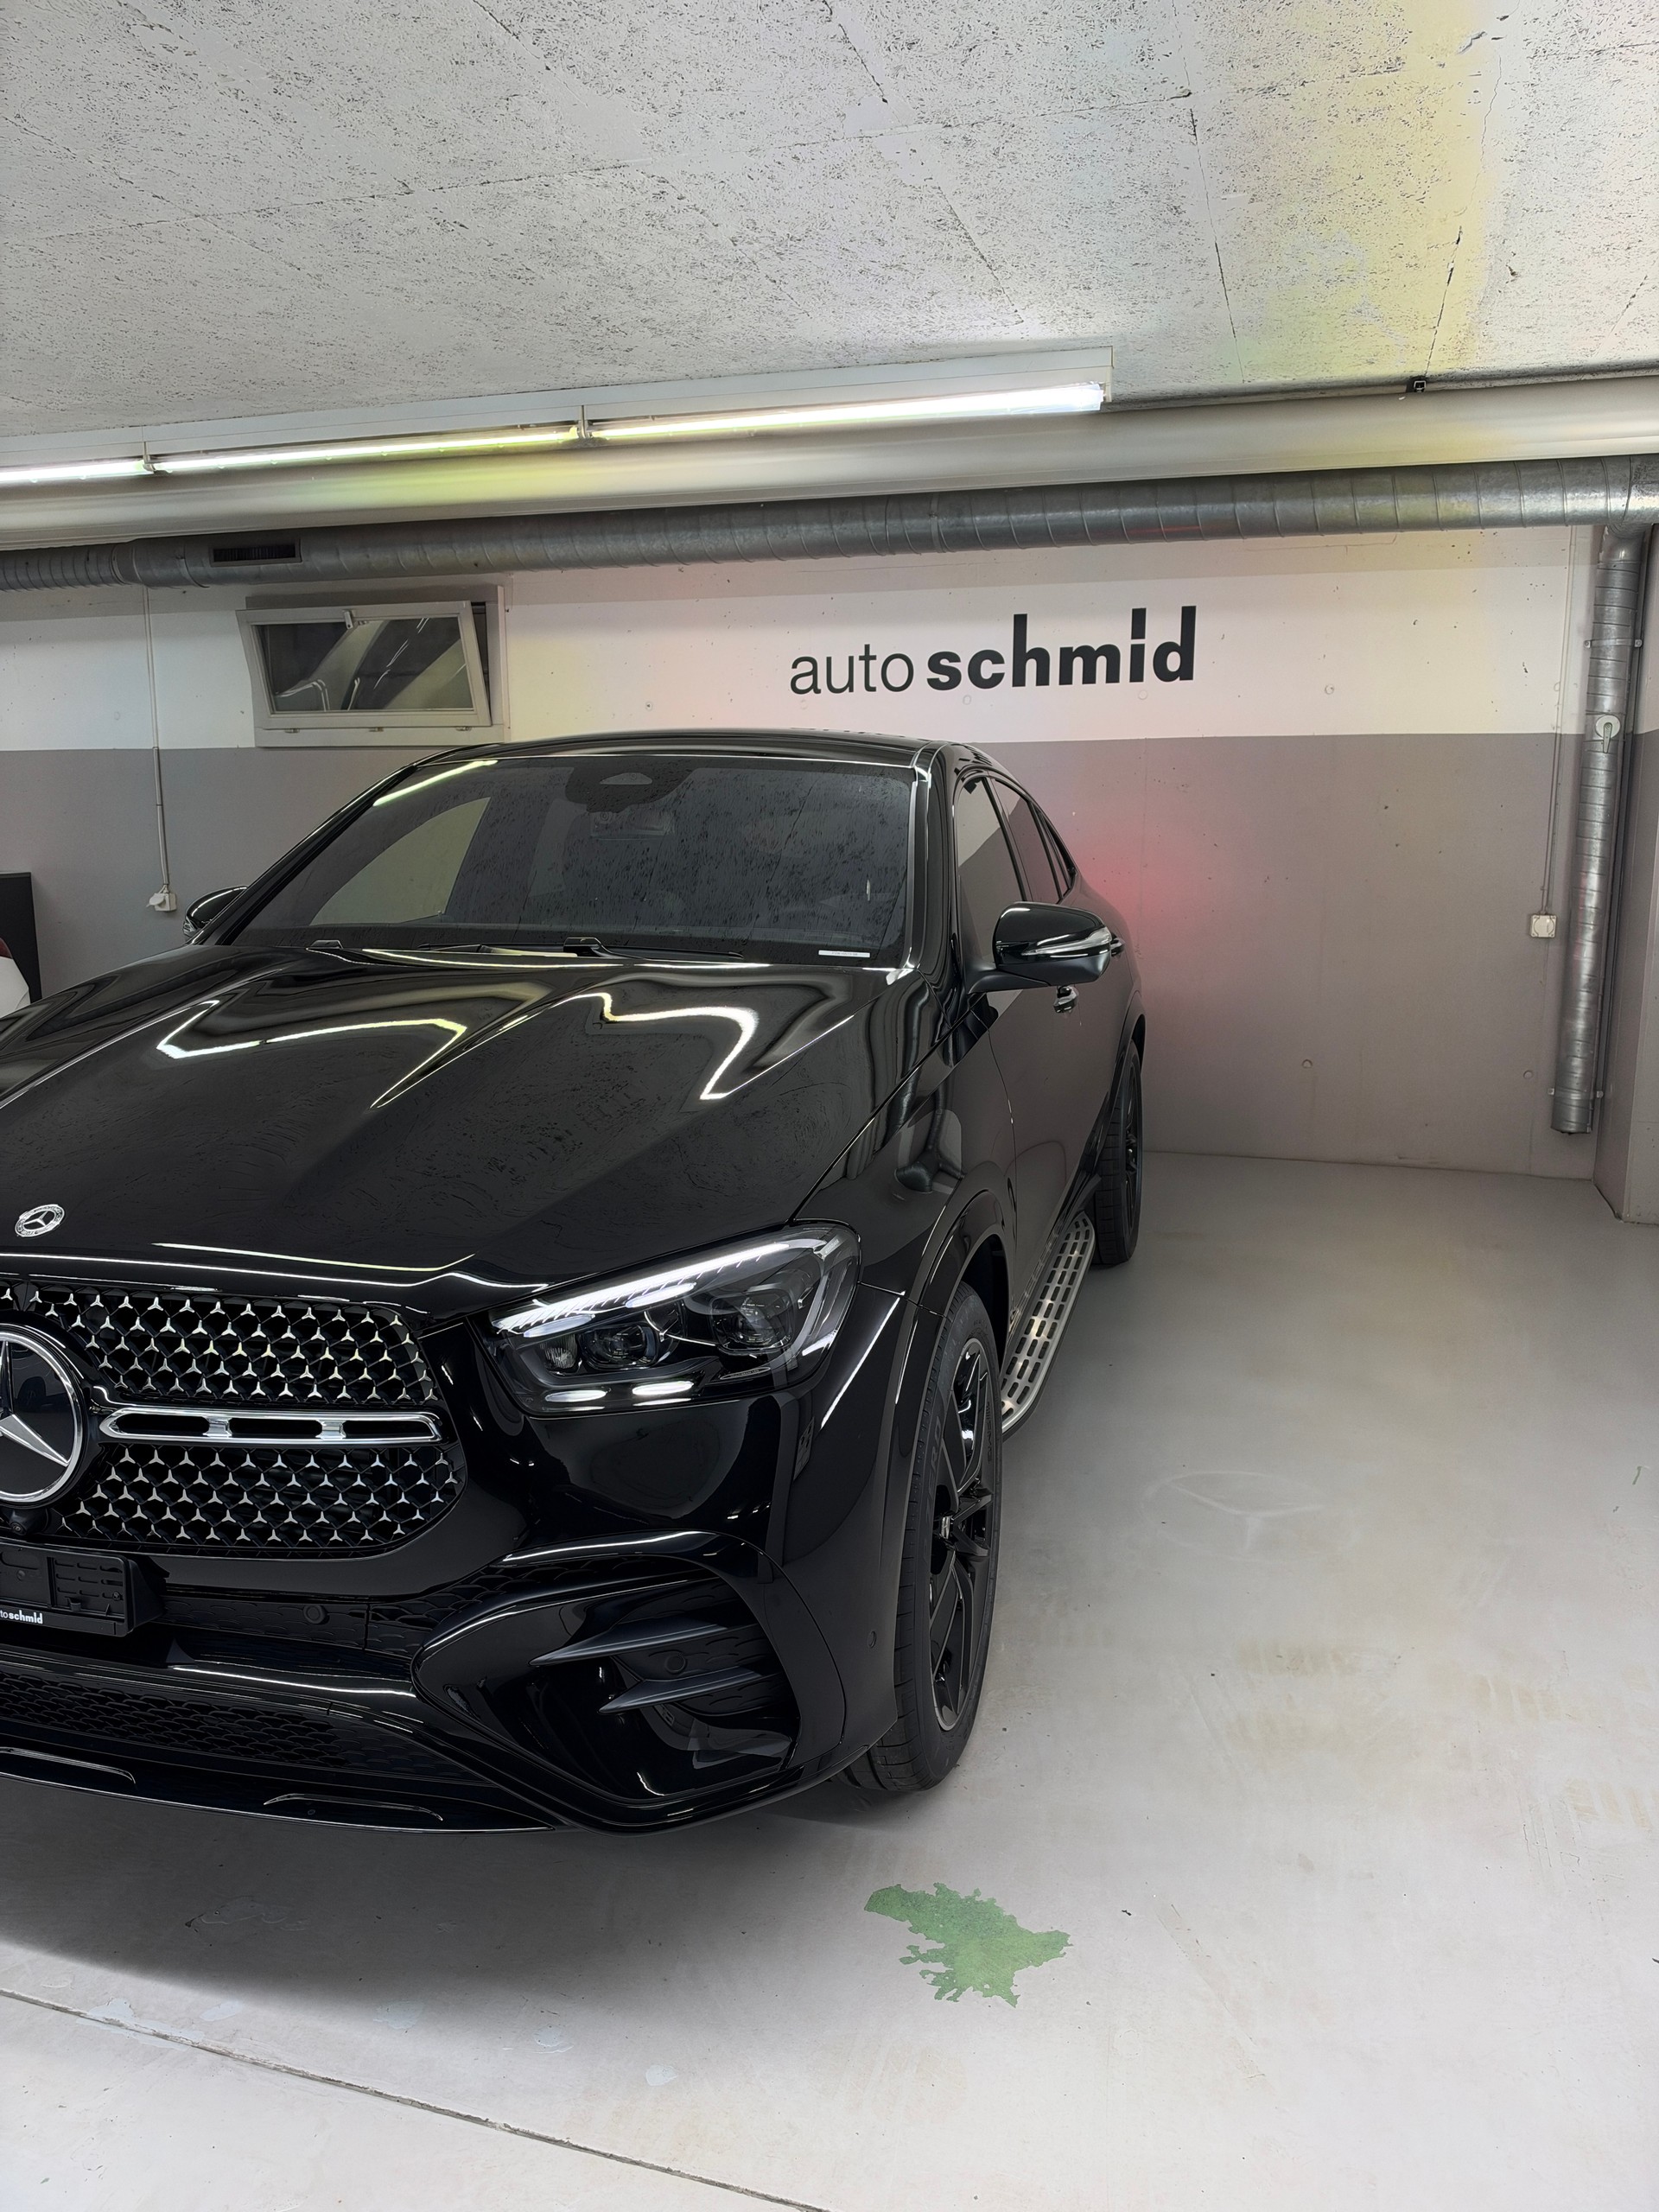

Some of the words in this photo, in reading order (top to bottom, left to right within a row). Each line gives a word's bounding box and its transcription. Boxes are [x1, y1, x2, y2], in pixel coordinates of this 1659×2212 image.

[790, 644, 914, 695] auto
[926, 606, 1197, 690] schmid
[925, 1414, 942, 1523] ZERO
